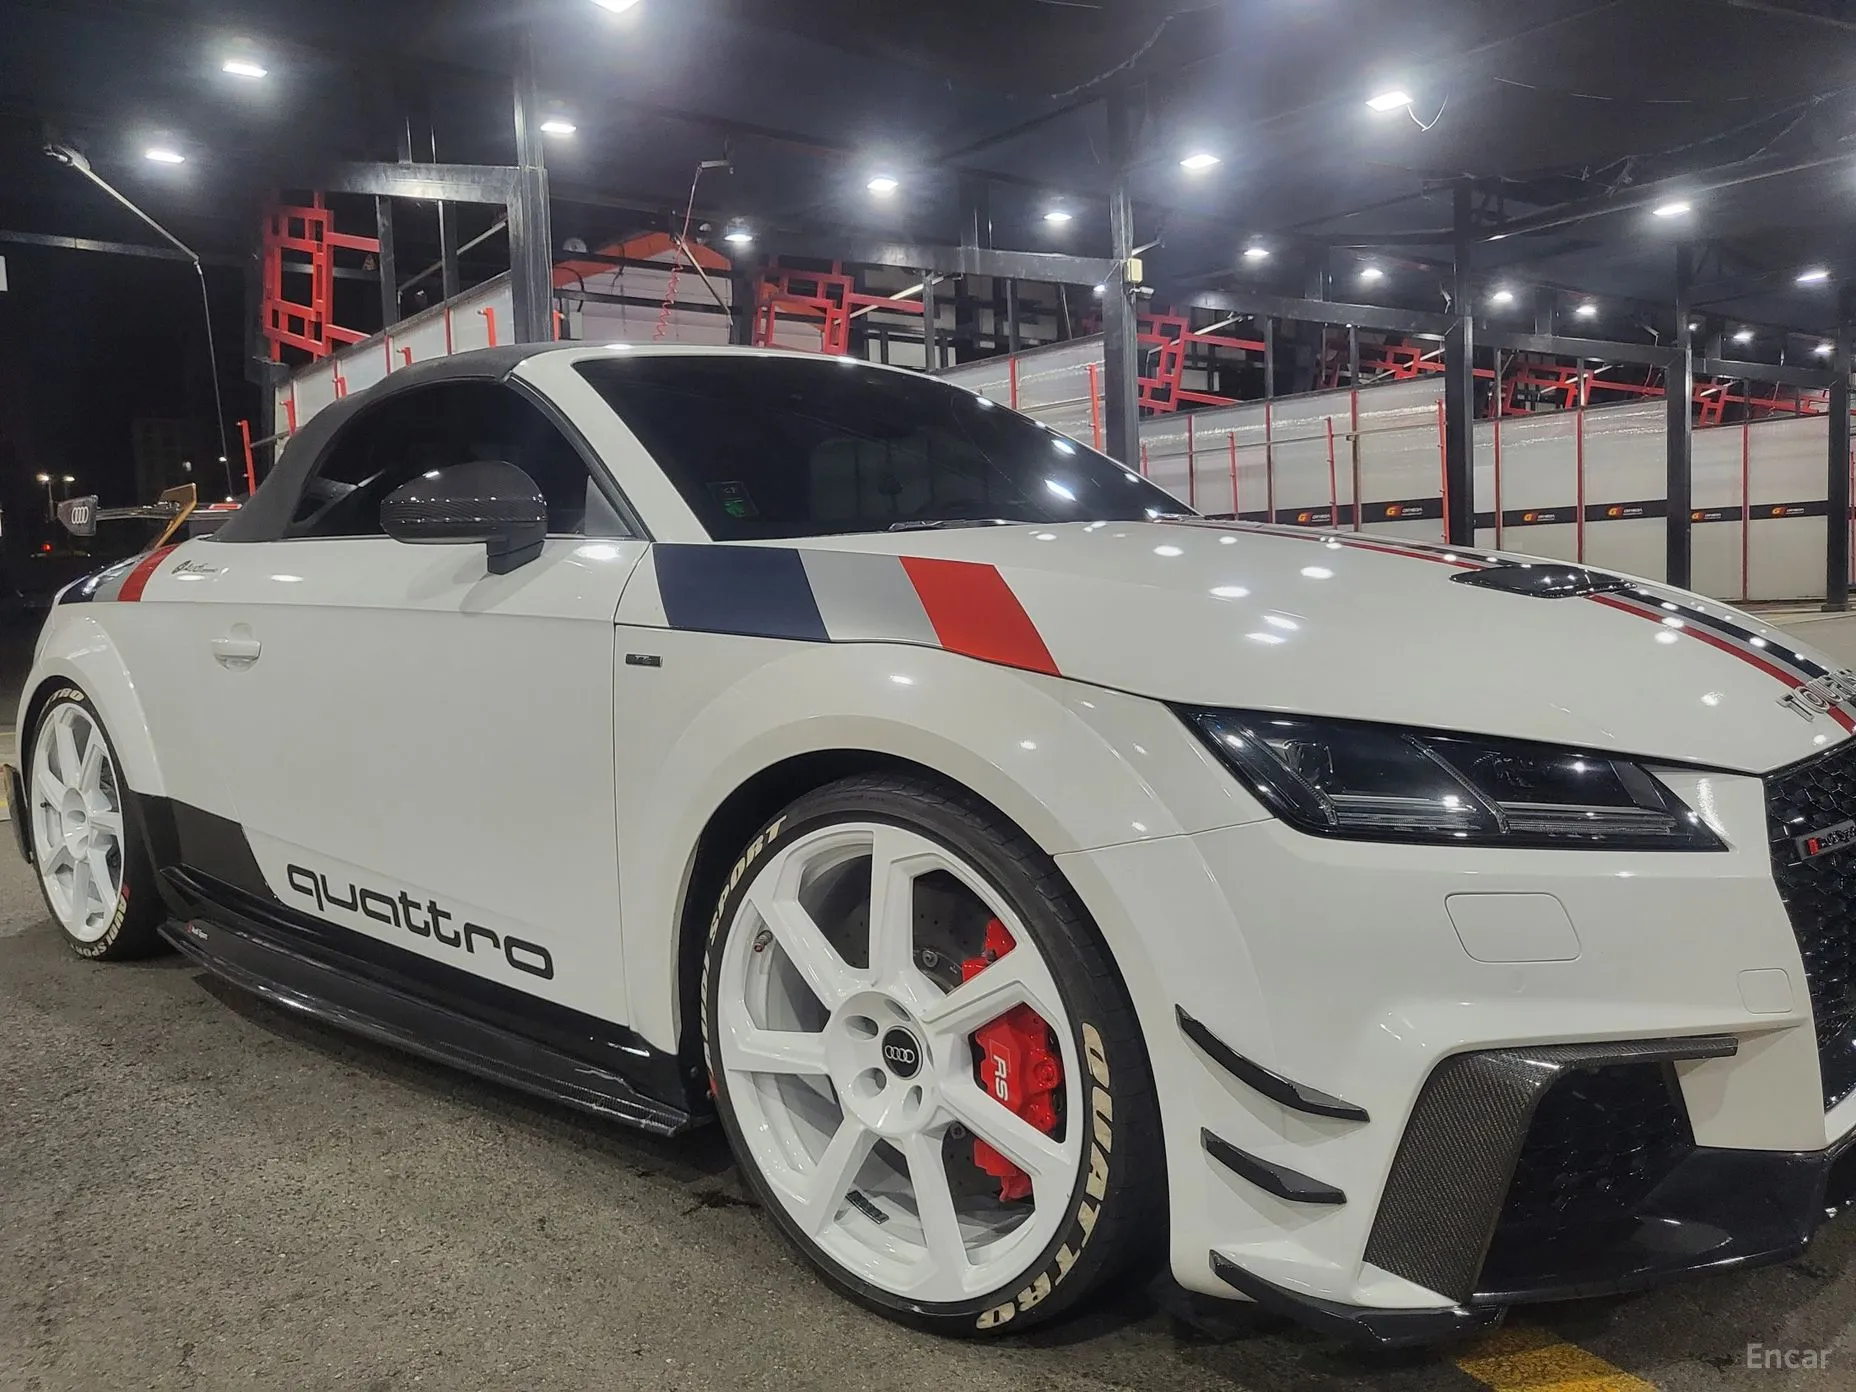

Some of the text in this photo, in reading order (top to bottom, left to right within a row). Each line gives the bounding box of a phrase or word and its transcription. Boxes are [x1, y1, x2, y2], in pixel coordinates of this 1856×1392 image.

[287, 863, 554, 980] quattro
[709, 815, 787, 946] SPORT
[993, 1054, 1009, 1101] RS
[976, 1022, 1113, 1330] QUATTRO
